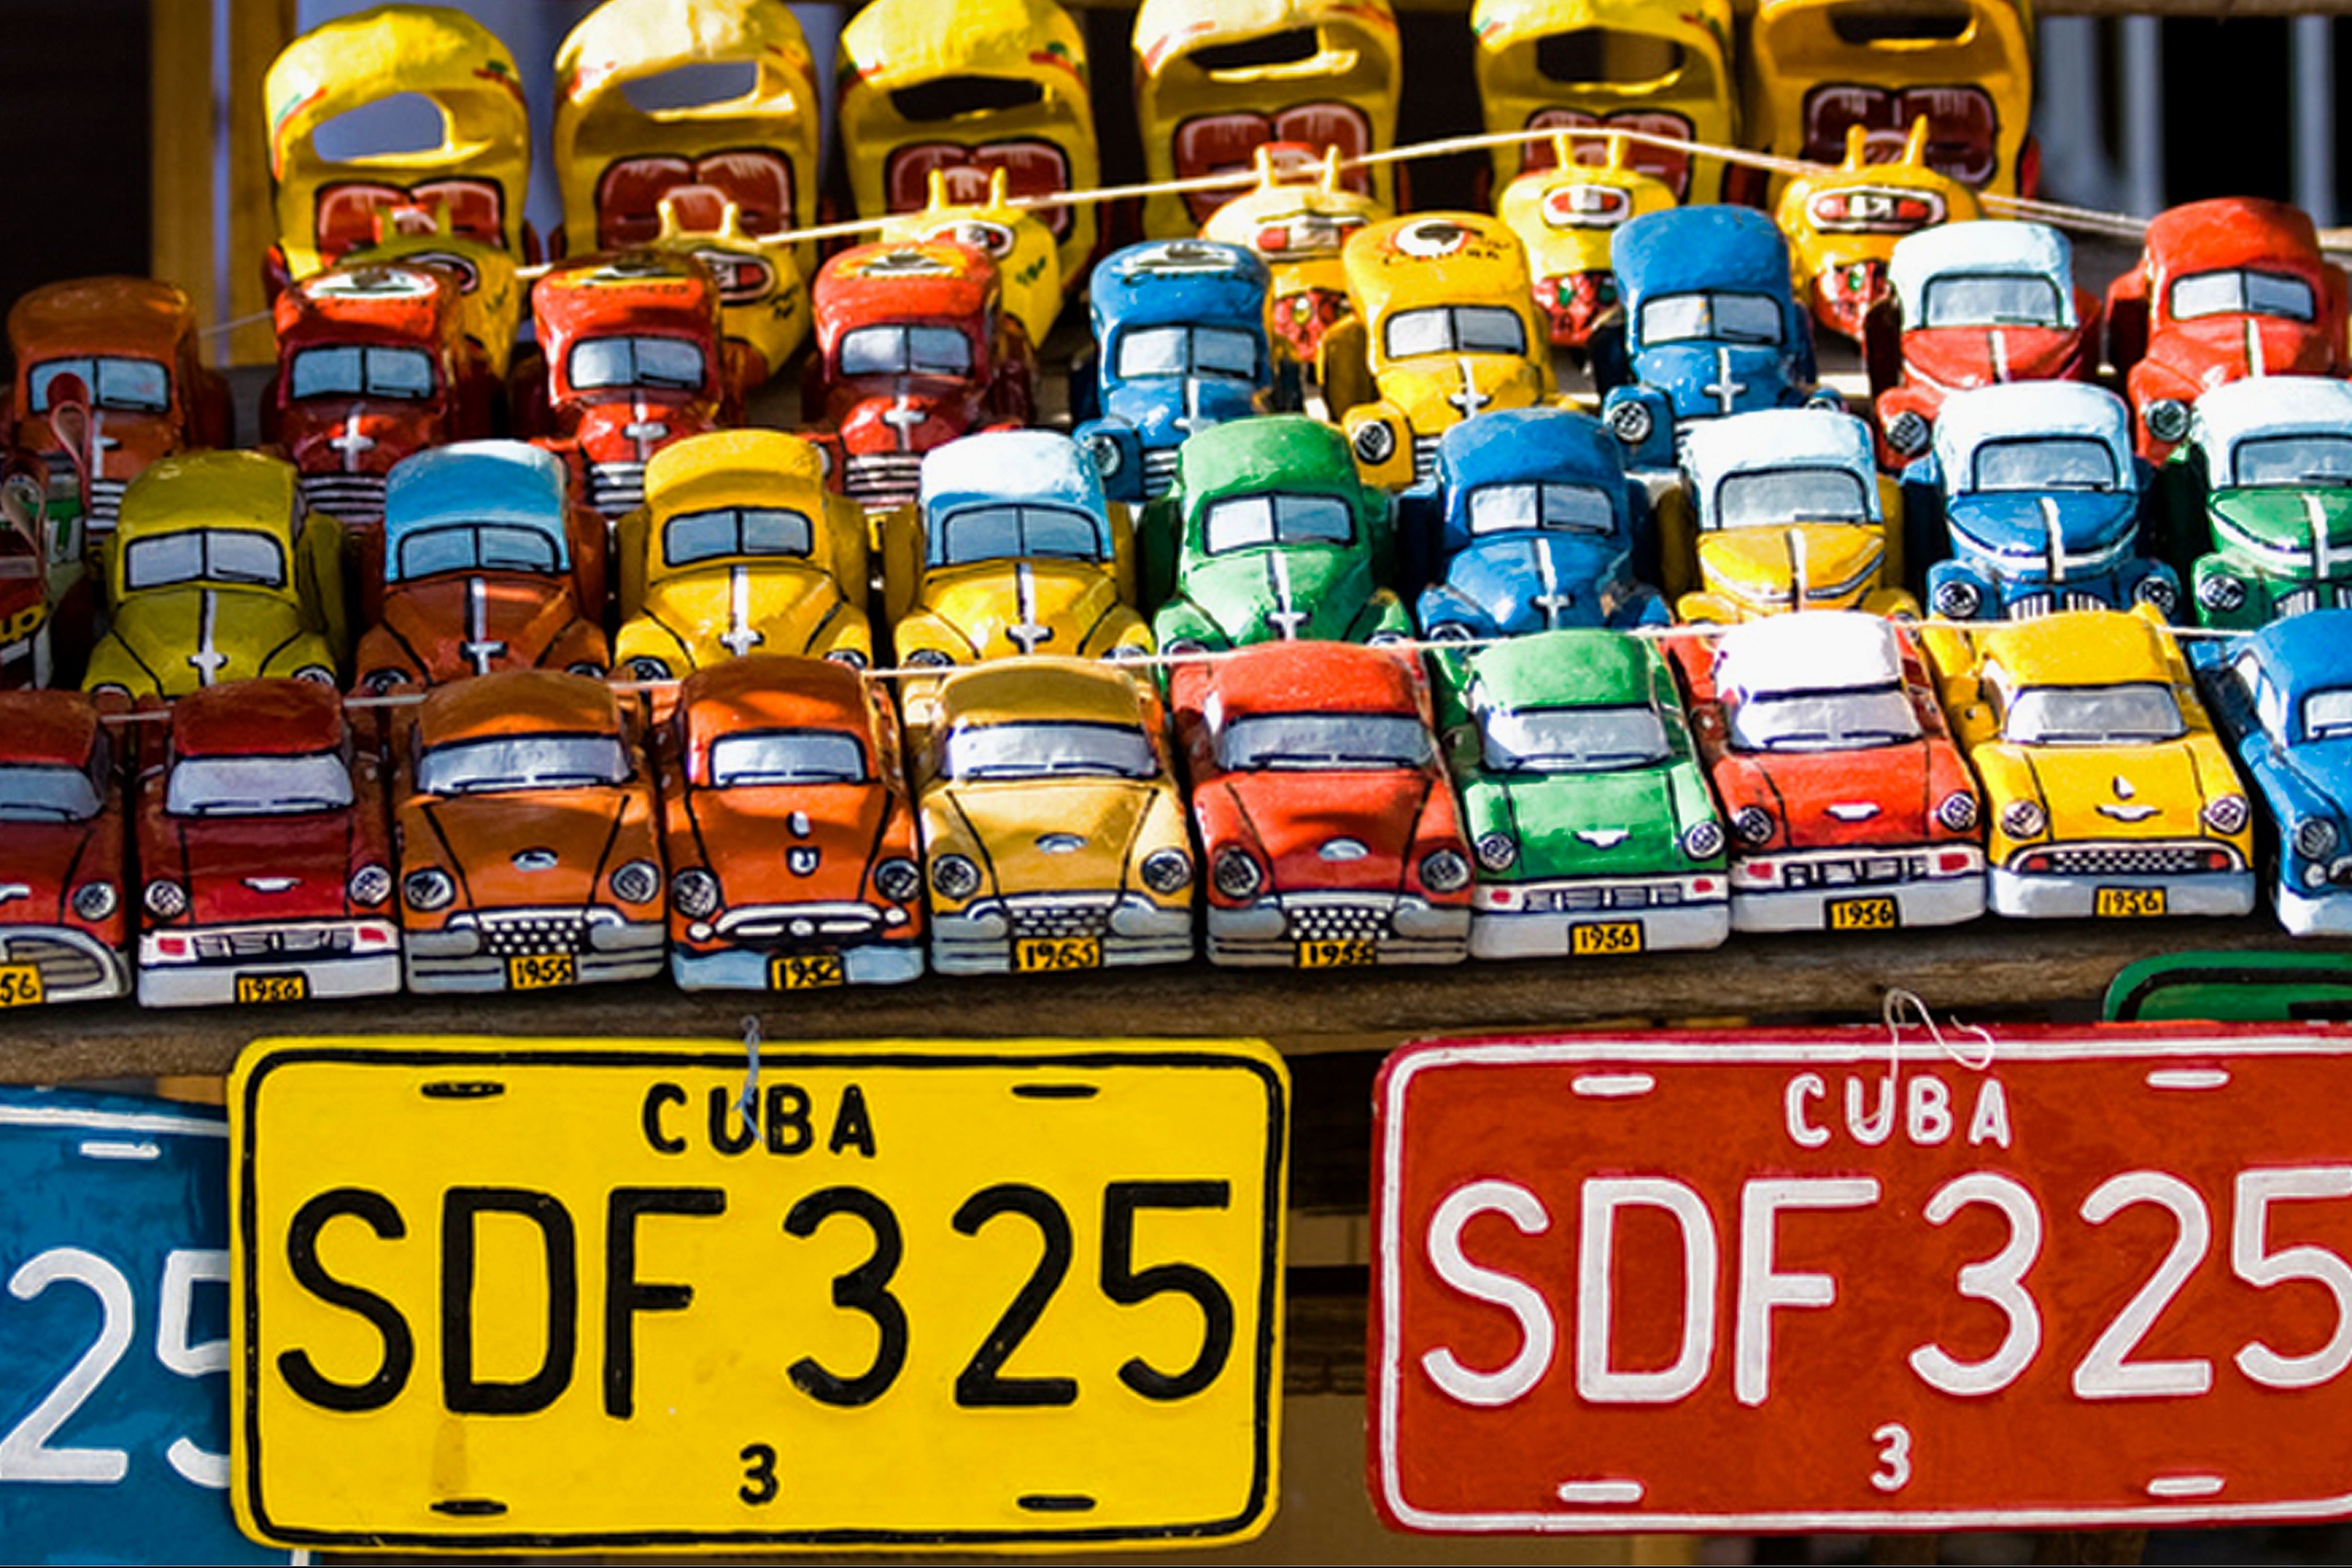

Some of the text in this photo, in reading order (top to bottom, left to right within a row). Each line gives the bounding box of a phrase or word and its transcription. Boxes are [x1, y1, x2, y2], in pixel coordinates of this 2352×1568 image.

[1839, 901, 1897, 925] 1956
[2103, 890, 2159, 915] 1956
[1581, 924, 1634, 949] 1956
[1, 973, 37, 1003] 56
[642, 1082, 877, 1158] CUBA
[1785, 1073, 2011, 1148] CUBA
[276, 1180, 1235, 1420] SDF 325
[1422, 1166, 2352, 1406] SDF 325
[739, 1444, 779, 1506] 3
[1871, 1423, 1911, 1491] 3
